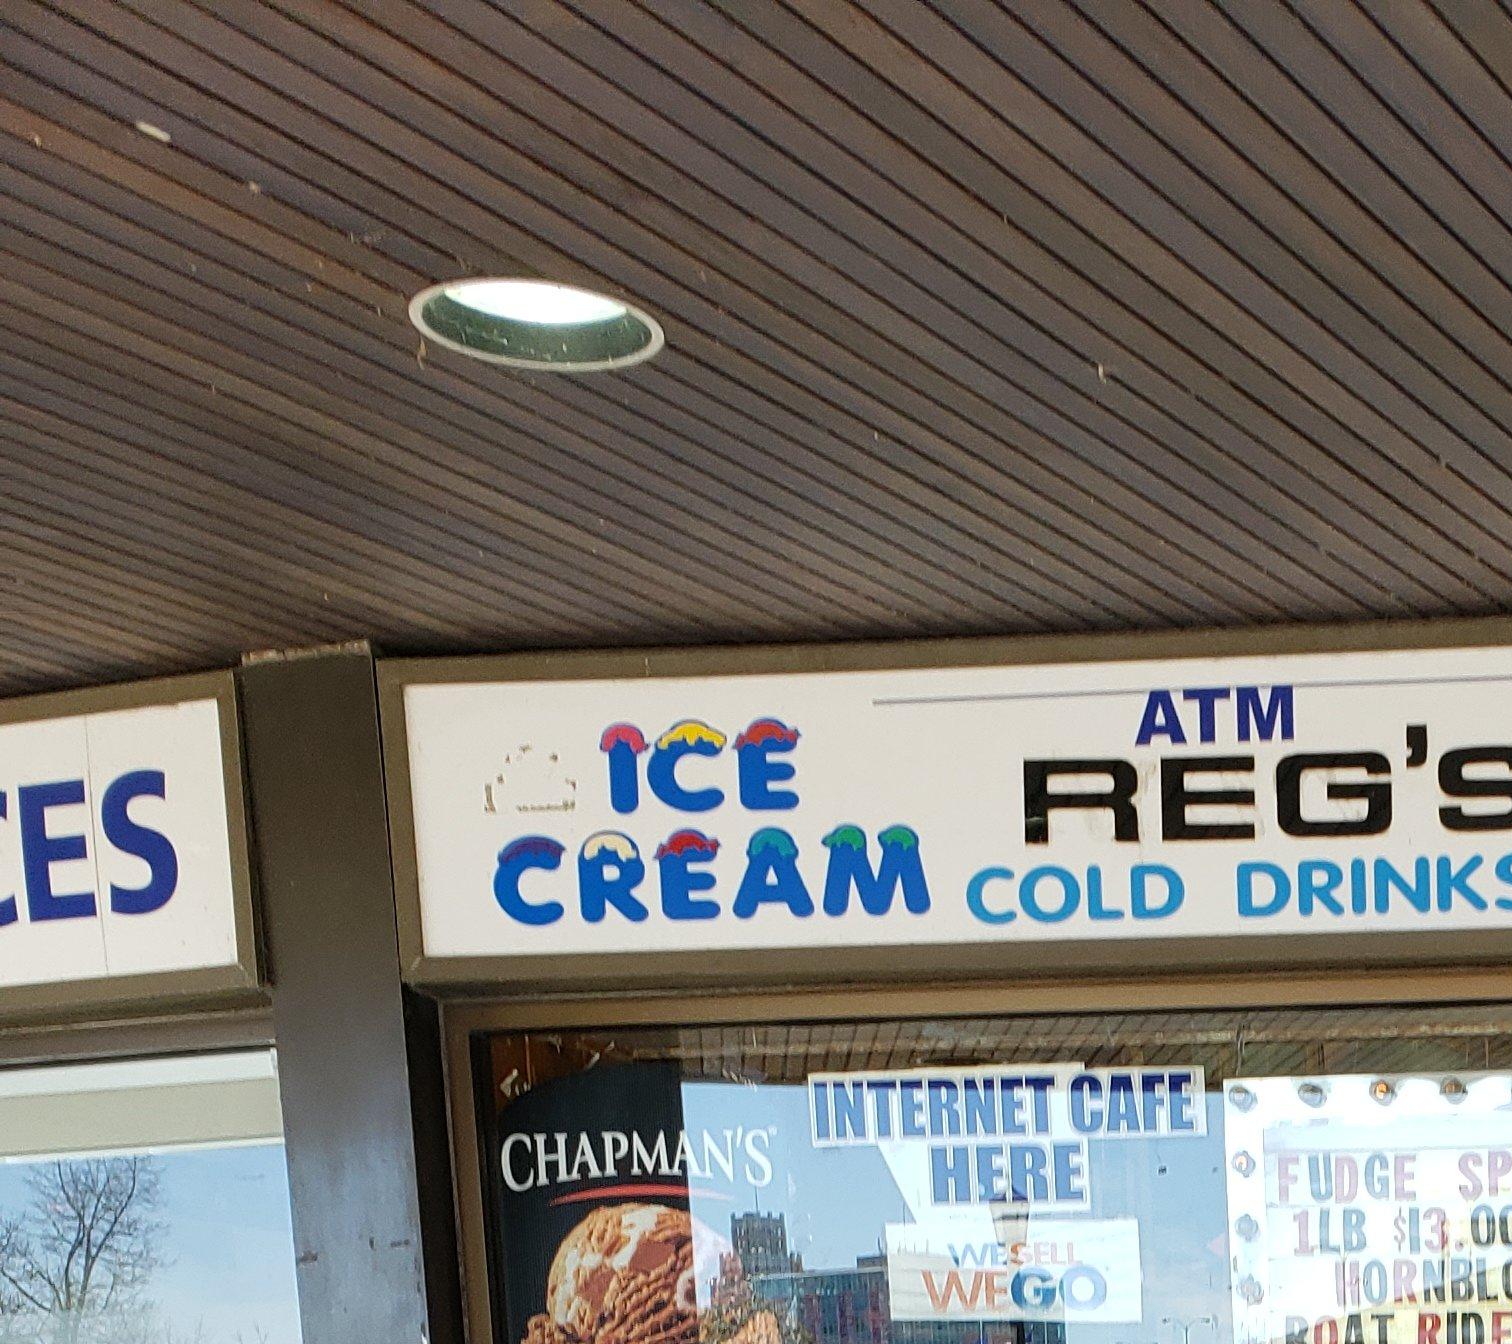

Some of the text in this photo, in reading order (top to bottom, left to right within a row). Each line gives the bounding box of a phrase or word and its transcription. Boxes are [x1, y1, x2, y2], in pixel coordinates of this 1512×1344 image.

[1134, 684, 1297, 747] ATM
[600, 717, 801, 814] ICE
[0, 768, 180, 926] ES
[492, 822, 932, 926] CREAM
[966, 863, 1185, 925] COLD
[813, 1071, 1198, 1140] INTERNET CAFE
[500, 1125, 775, 1193] CHAPMAN'S
[929, 1140, 1089, 1205] HERE
[1276, 1150, 1418, 1205] FUDGE
[1293, 1205, 1368, 1258] 1LB
[920, 1264, 1109, 1313] WEGO
